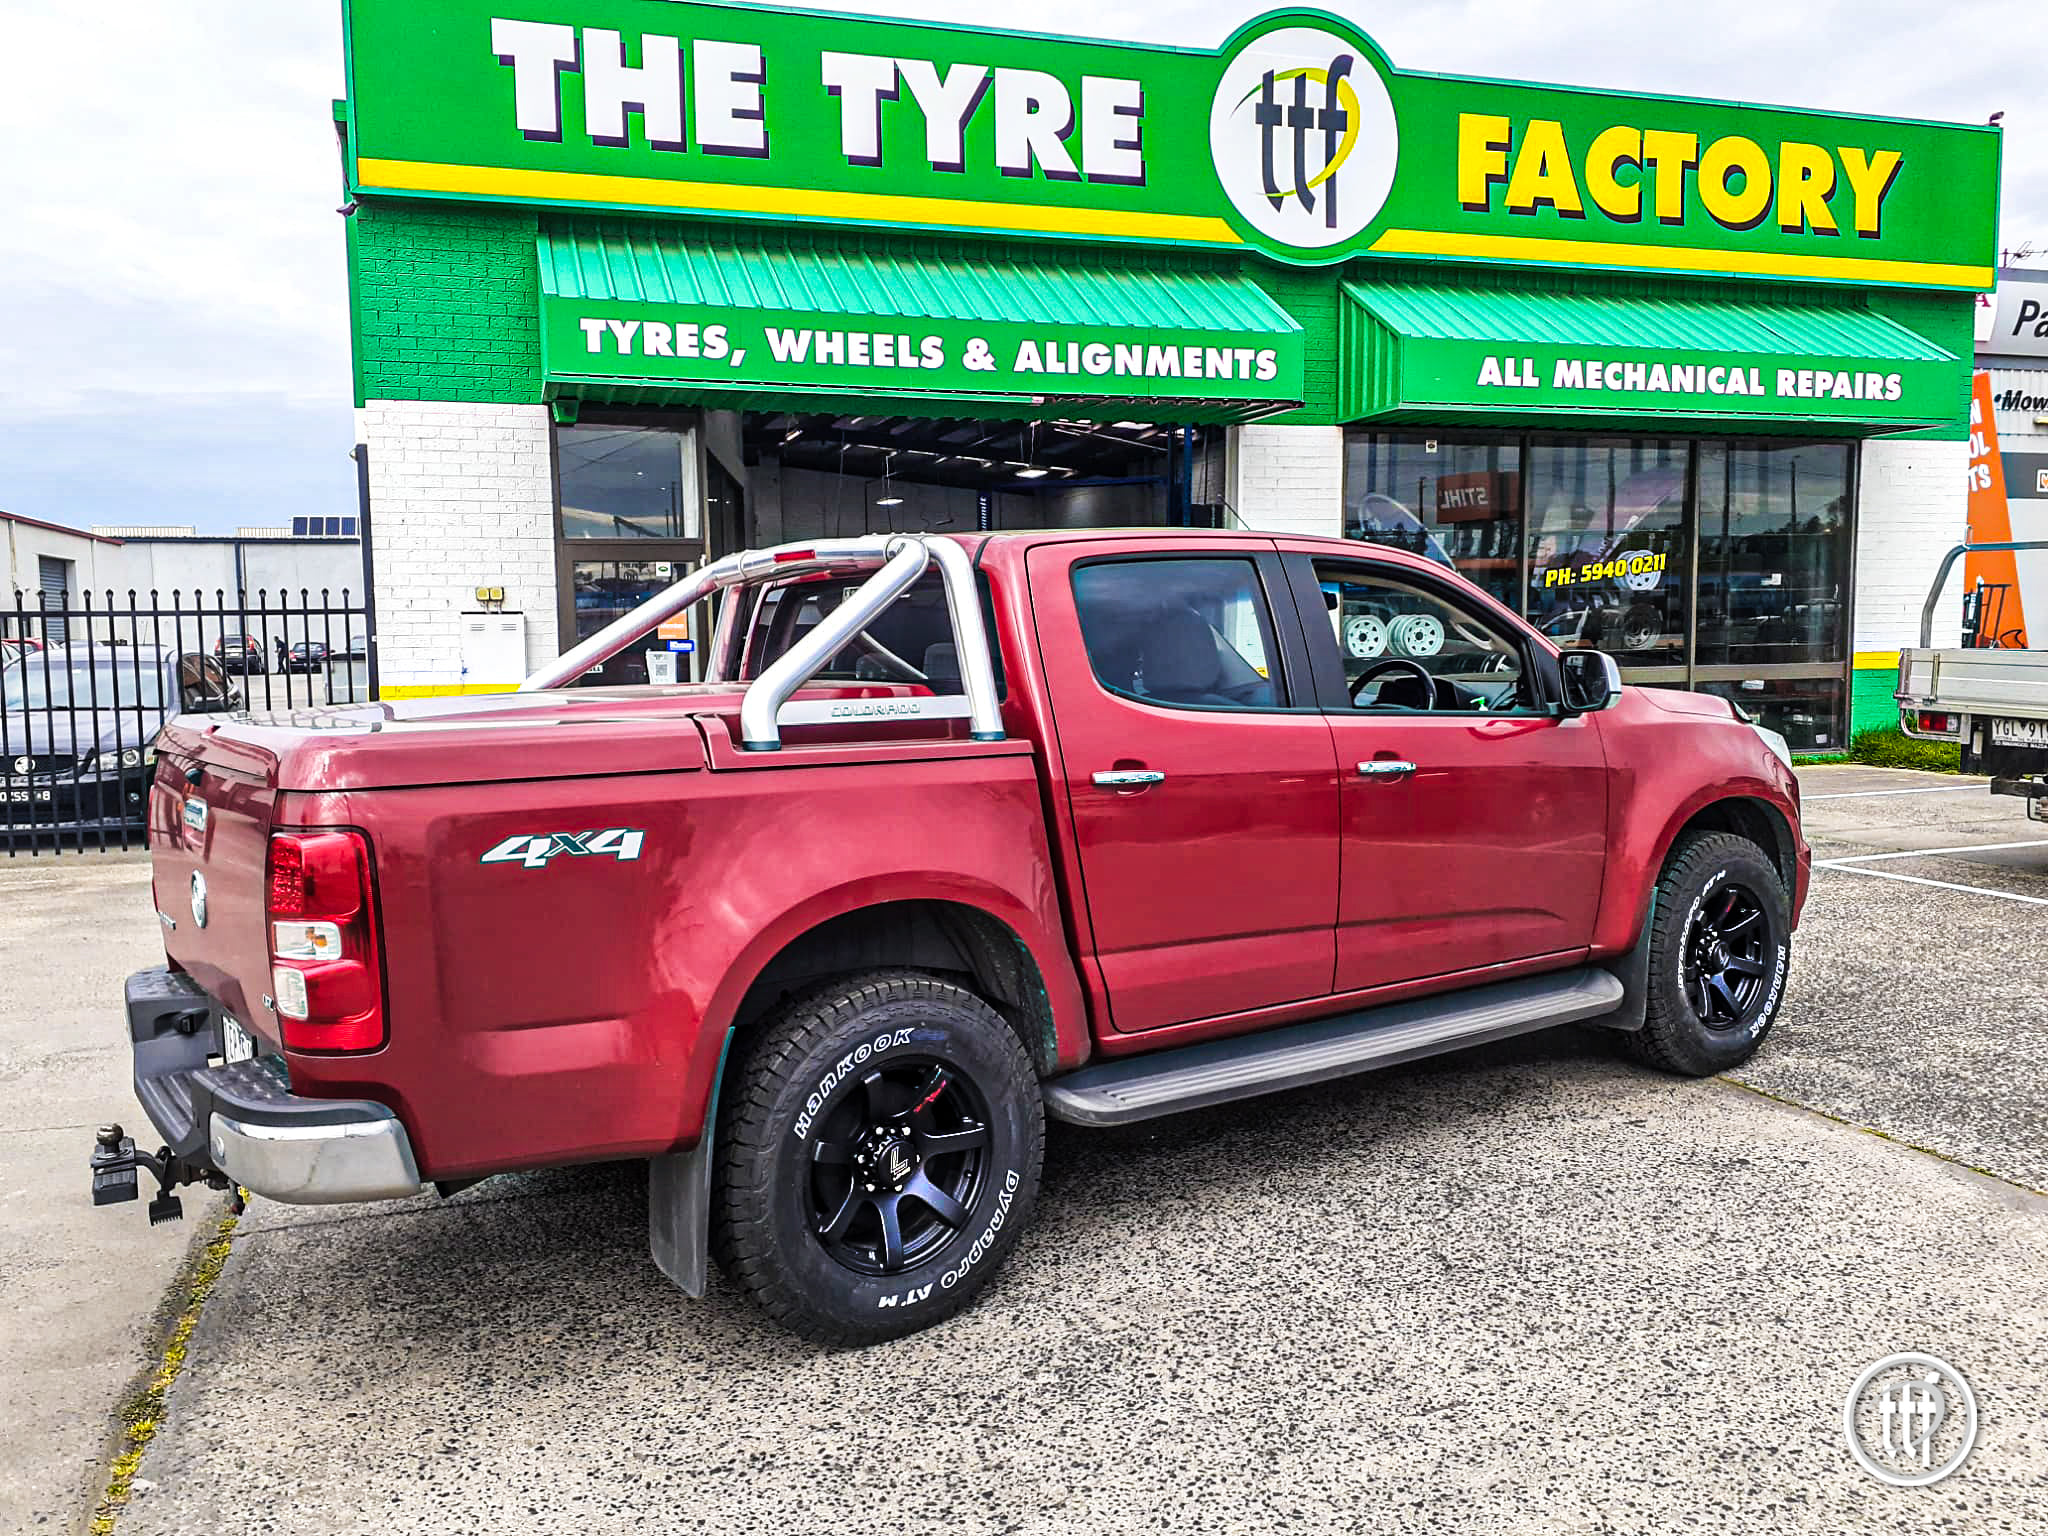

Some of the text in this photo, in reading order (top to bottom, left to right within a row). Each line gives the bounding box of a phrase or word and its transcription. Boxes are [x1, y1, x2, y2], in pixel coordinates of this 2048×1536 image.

[491, 17, 1146, 187] THE TYRE
[1255, 54, 1354, 228] ttf
[1458, 112, 1904, 240] FACTORY
[579, 317, 1278, 381] TYRES, WHEELS & ALIGNMENTS
[1477, 356, 1902, 401] ALL MECHANICAL REPAIRS
[1545, 553, 1667, 588] PH: 5940 0211
[831, 702, 921, 718] COLORADO
[1993, 719, 2048, 740] YGL 91
